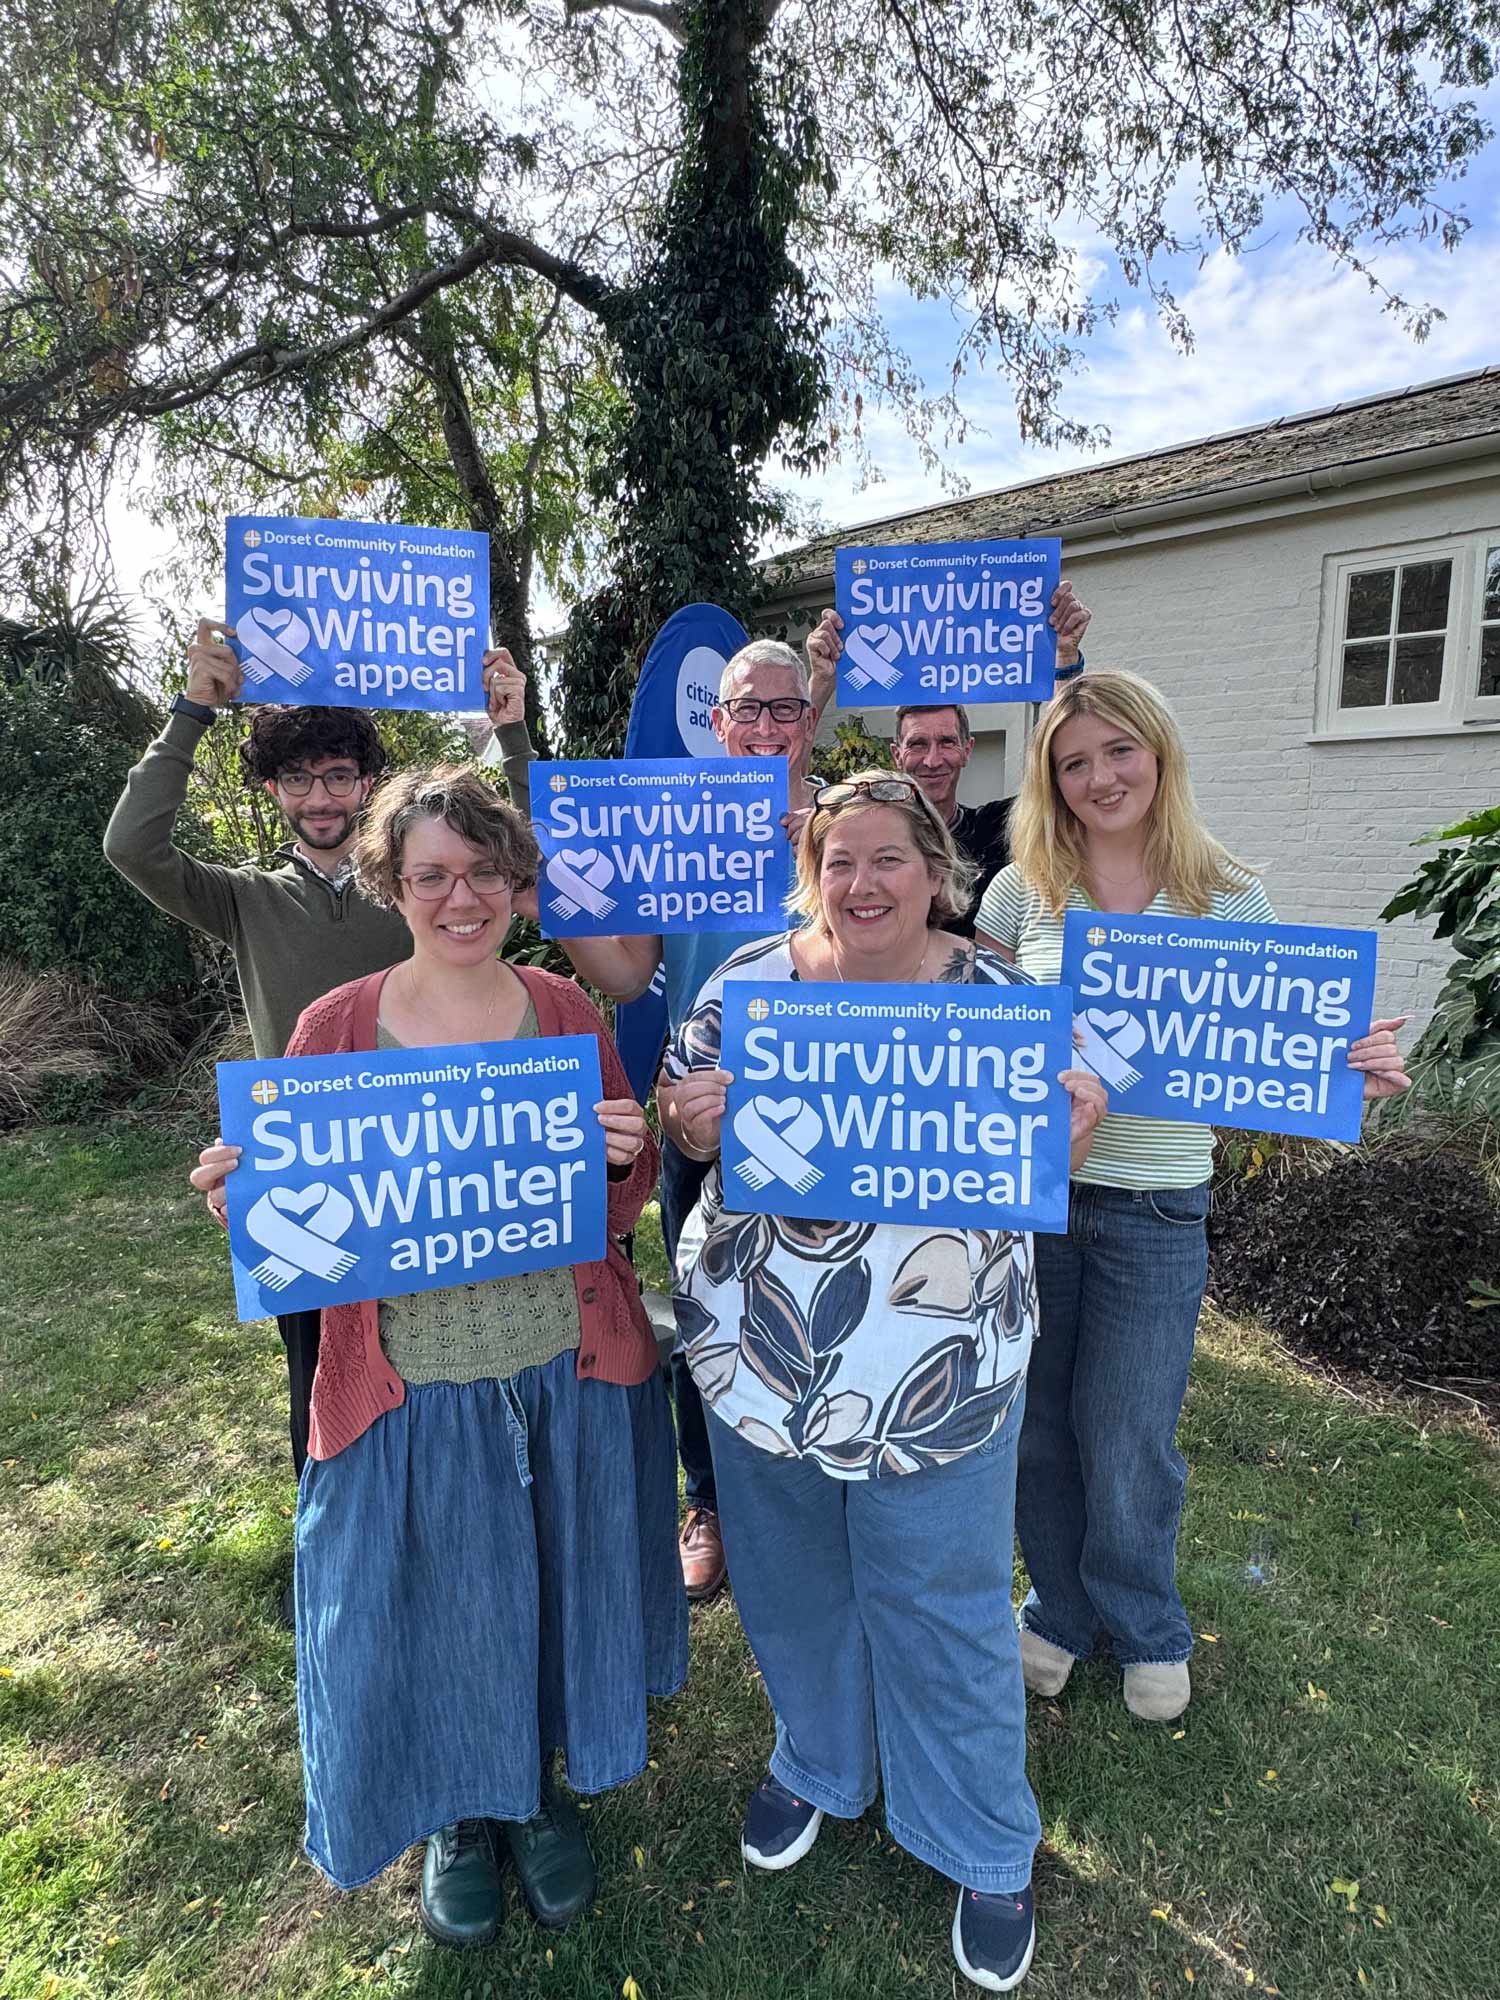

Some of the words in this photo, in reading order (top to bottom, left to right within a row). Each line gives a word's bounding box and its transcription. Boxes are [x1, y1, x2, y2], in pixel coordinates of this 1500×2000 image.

[264, 531, 312, 547] Dorset
[315, 535, 396, 555] Community
[399, 540, 475, 559] Foundation
[869, 559, 907, 571] Dorset
[910, 555, 978, 569] Community
[981, 552, 1047, 564] Foundation
[243, 552, 475, 619] Surviving
[851, 570, 1044, 617] Surviving
[306, 608, 476, 657] Winter
[902, 616, 1044, 655] Winter
[334, 658, 465, 697] appeal
[687, 681, 720, 707] citize
[919, 653, 1033, 693] appeal
[569, 774, 617, 788] Dorset
[620, 773, 696, 787] Community
[700, 771, 774, 784] Foundation
[549, 790, 774, 842] Surviving
[611, 840, 774, 883] Winter
[637, 880, 764, 922] appeal
[1110, 929, 1163, 946] Dorset
[1167, 933, 1261, 955] Community
[1264, 940, 1358, 960] Foundation
[773, 999, 834, 1017] Dorset
[837, 1002, 942, 1022] Community
[946, 1003, 1051, 1021] Foundation
[1080, 951, 1351, 1027] Surviving
[1146, 1009, 1348, 1072] Winter
[283, 1074, 354, 1096] Dorset
[357, 1065, 472, 1089] Community
[476, 1058, 580, 1079] Foundation
[744, 1026, 1049, 1103] Surviving
[1165, 1069, 1329, 1114] appeal
[252, 1086, 585, 1171] Surviving
[821, 1092, 1048, 1157] Winter
[348, 1159, 586, 1228] Winter
[850, 1158, 1032, 1210] appeal
[390, 1202, 572, 1275] appeal
